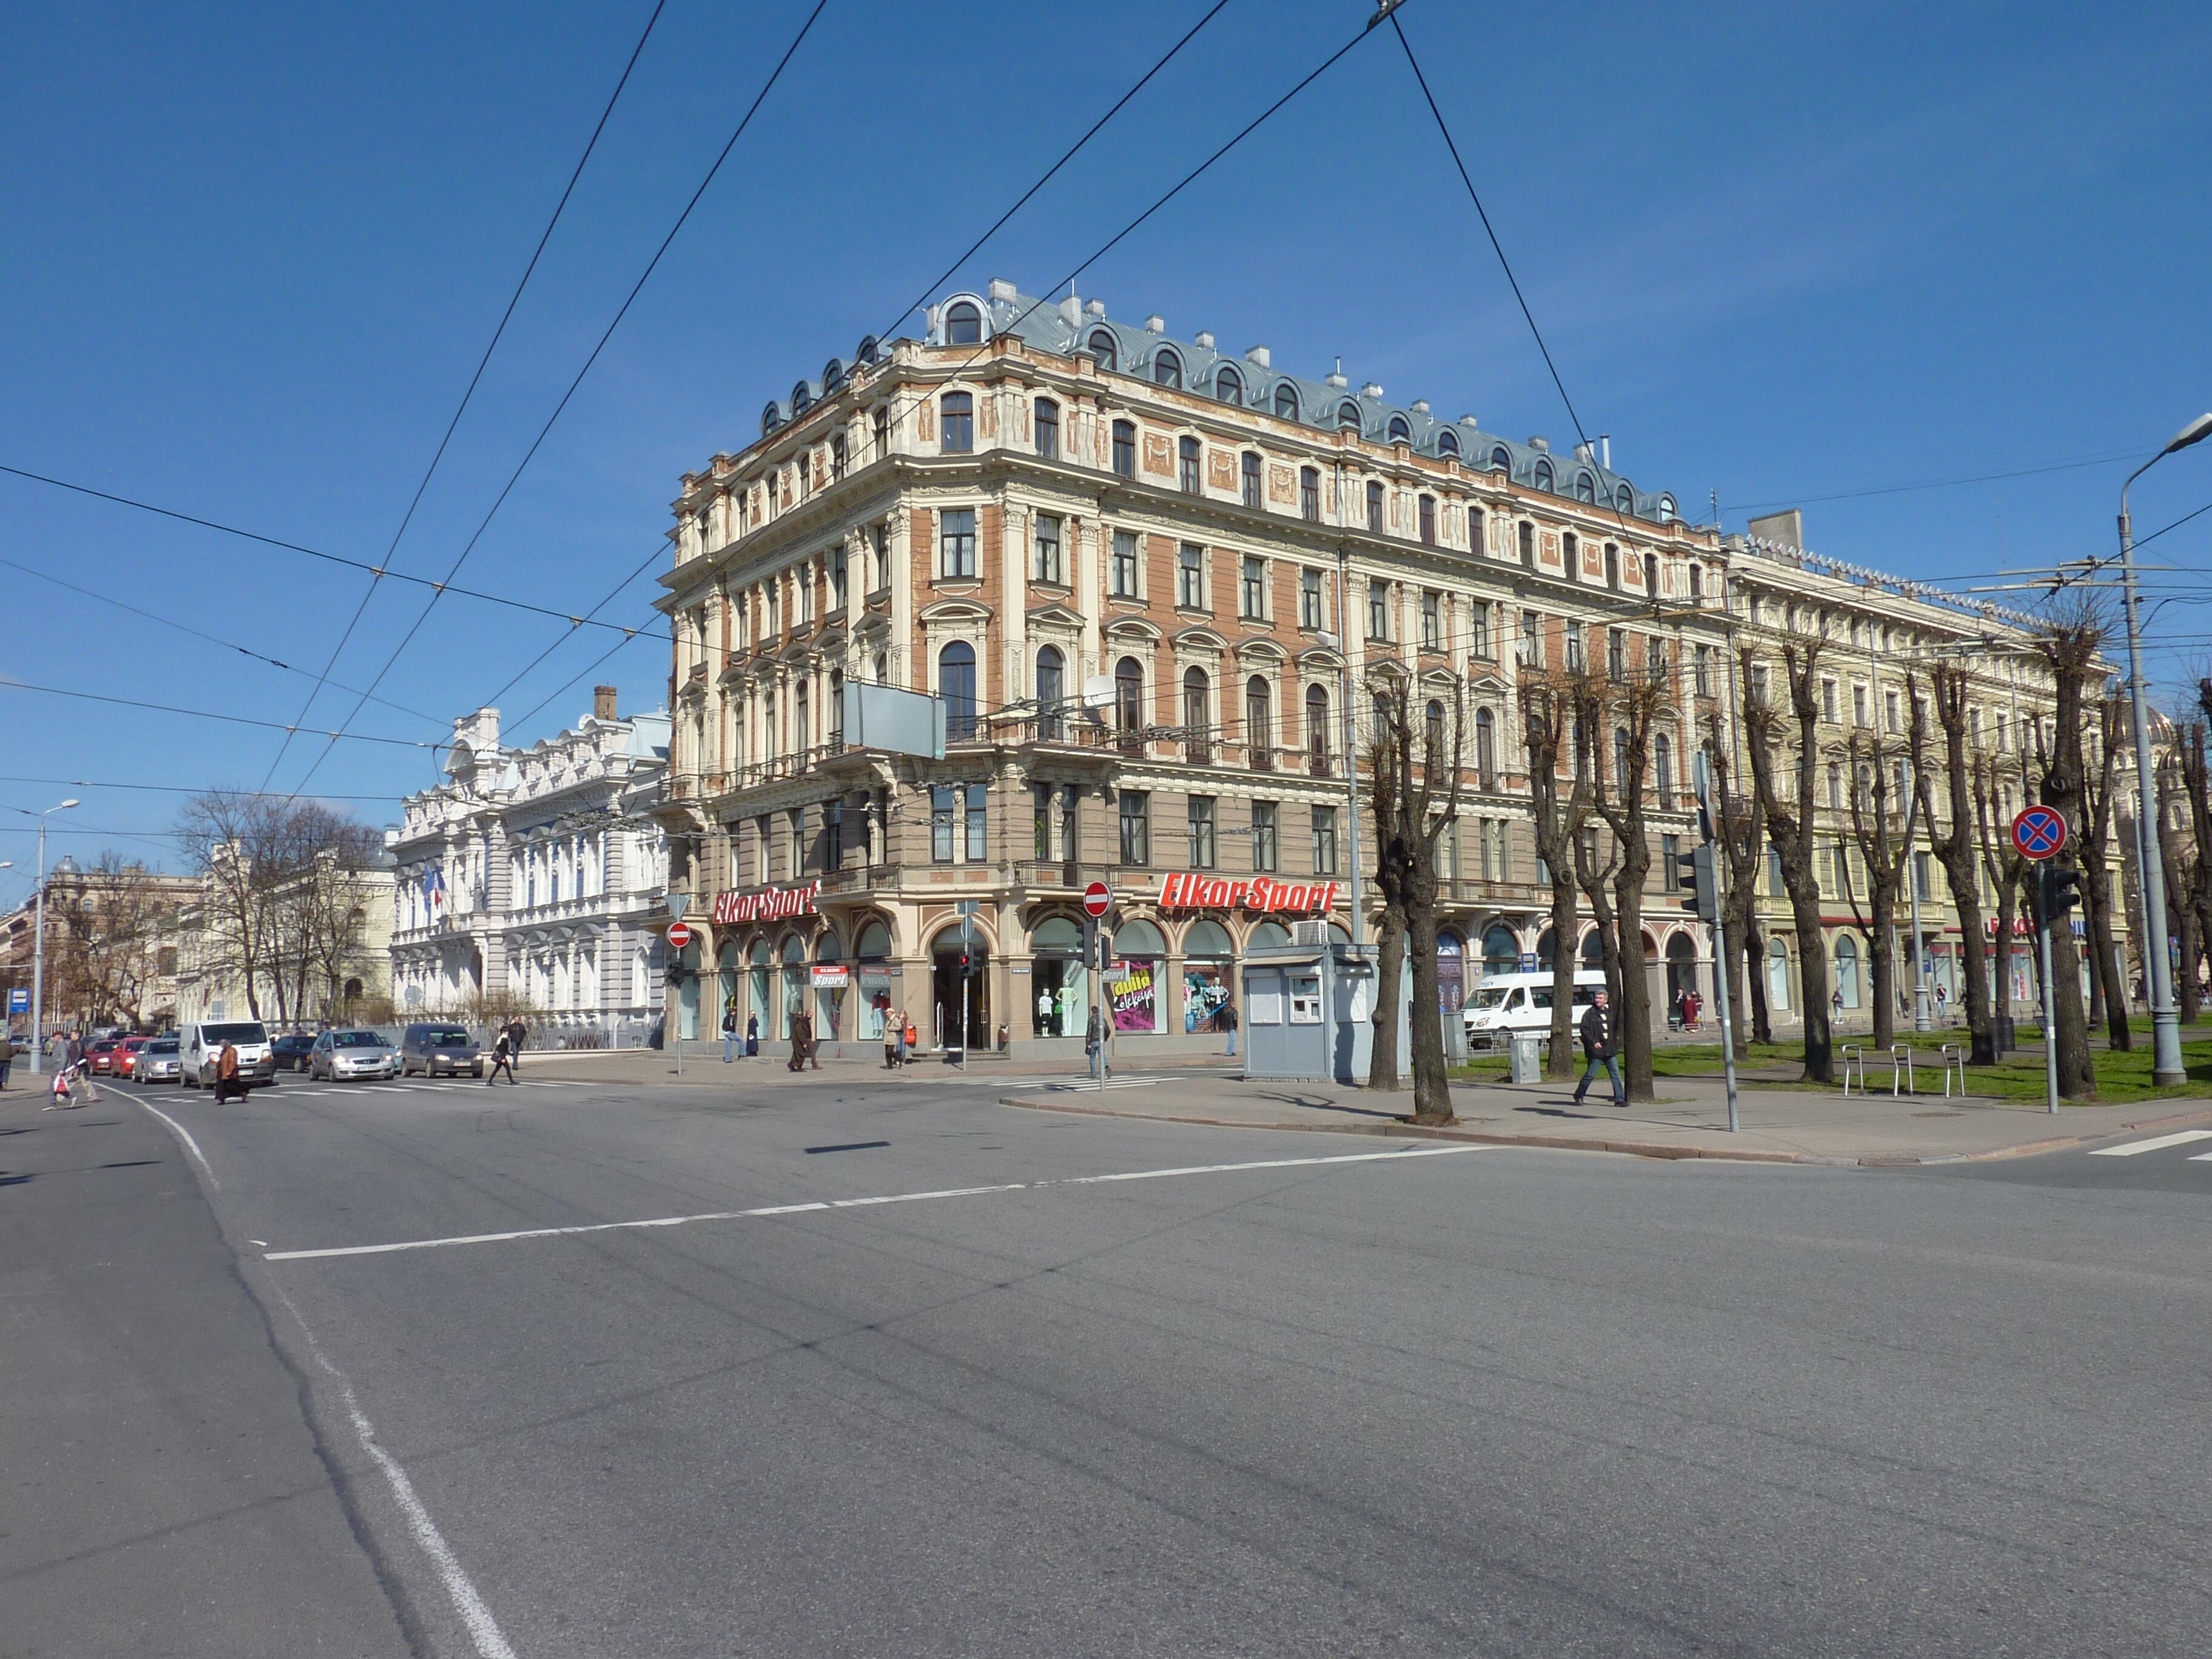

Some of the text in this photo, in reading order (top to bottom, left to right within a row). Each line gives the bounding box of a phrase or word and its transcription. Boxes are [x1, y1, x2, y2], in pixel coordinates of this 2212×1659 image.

[712, 880, 821, 924] Elkor Sport
[1158, 873, 1337, 912] Elkor Sport
[814, 975, 845, 986] Sport
[1102, 970, 1124, 980] Sport
